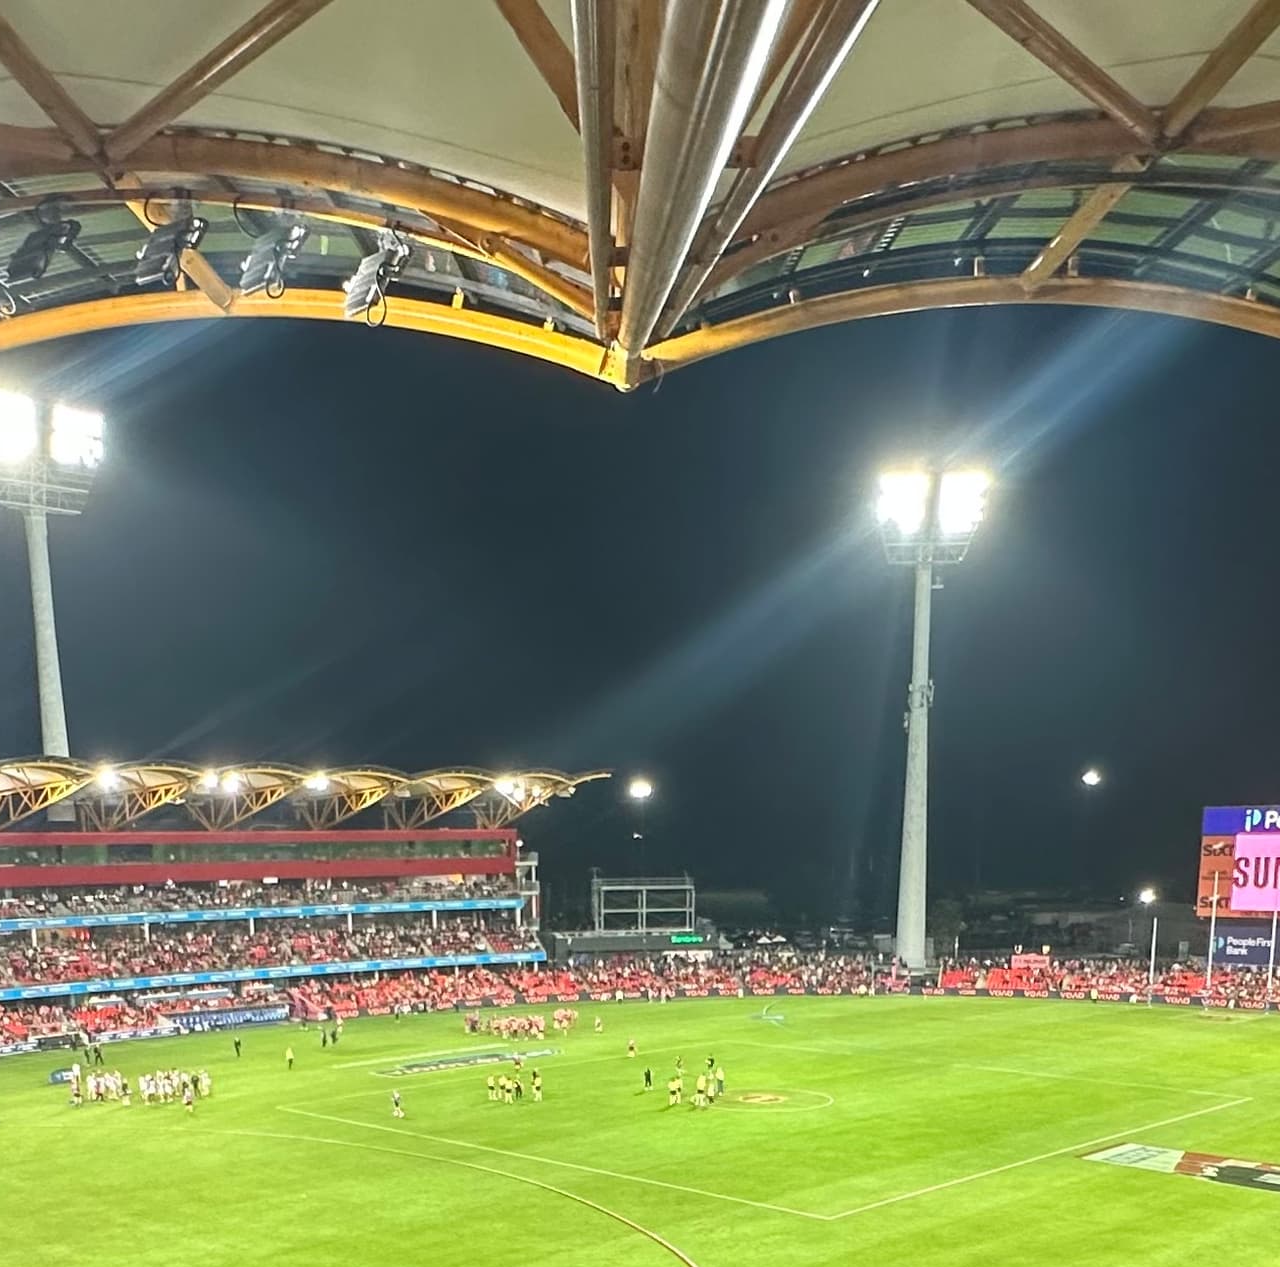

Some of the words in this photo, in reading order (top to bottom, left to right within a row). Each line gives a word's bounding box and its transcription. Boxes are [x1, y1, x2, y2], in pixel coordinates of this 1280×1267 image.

[1226, 936, 1254, 948] People
[1255, 938, 1273, 947] Firs
[1226, 946, 1248, 955] Bank
